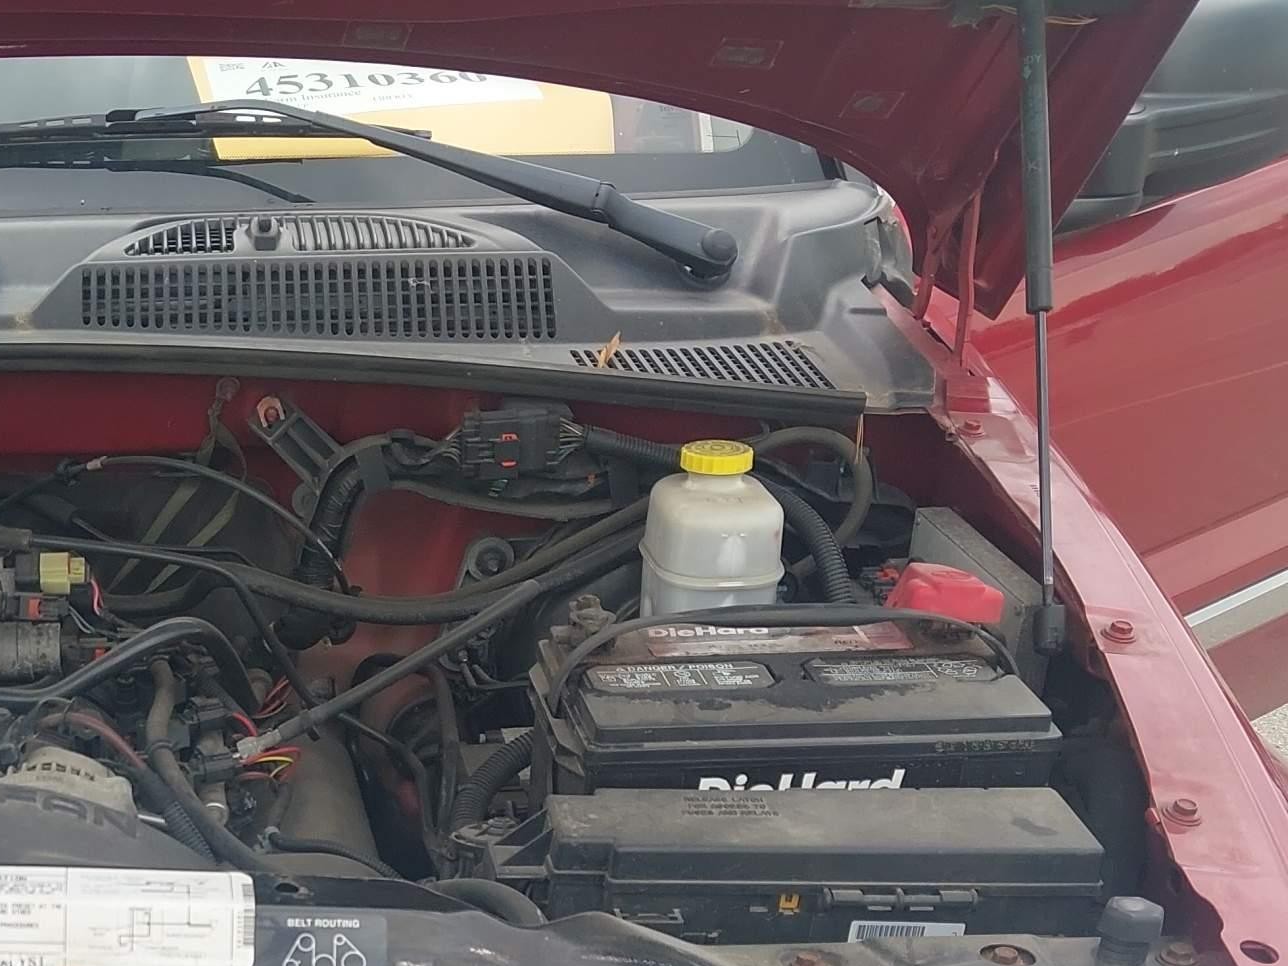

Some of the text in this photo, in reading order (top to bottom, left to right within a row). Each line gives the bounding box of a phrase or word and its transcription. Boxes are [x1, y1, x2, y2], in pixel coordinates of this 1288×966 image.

[246, 71, 488, 97] 45310360
[301, 90, 362, 101] Insurance
[627, 664, 676, 672] DANGER
[286, 917, 361, 929] BELT ROUTING
